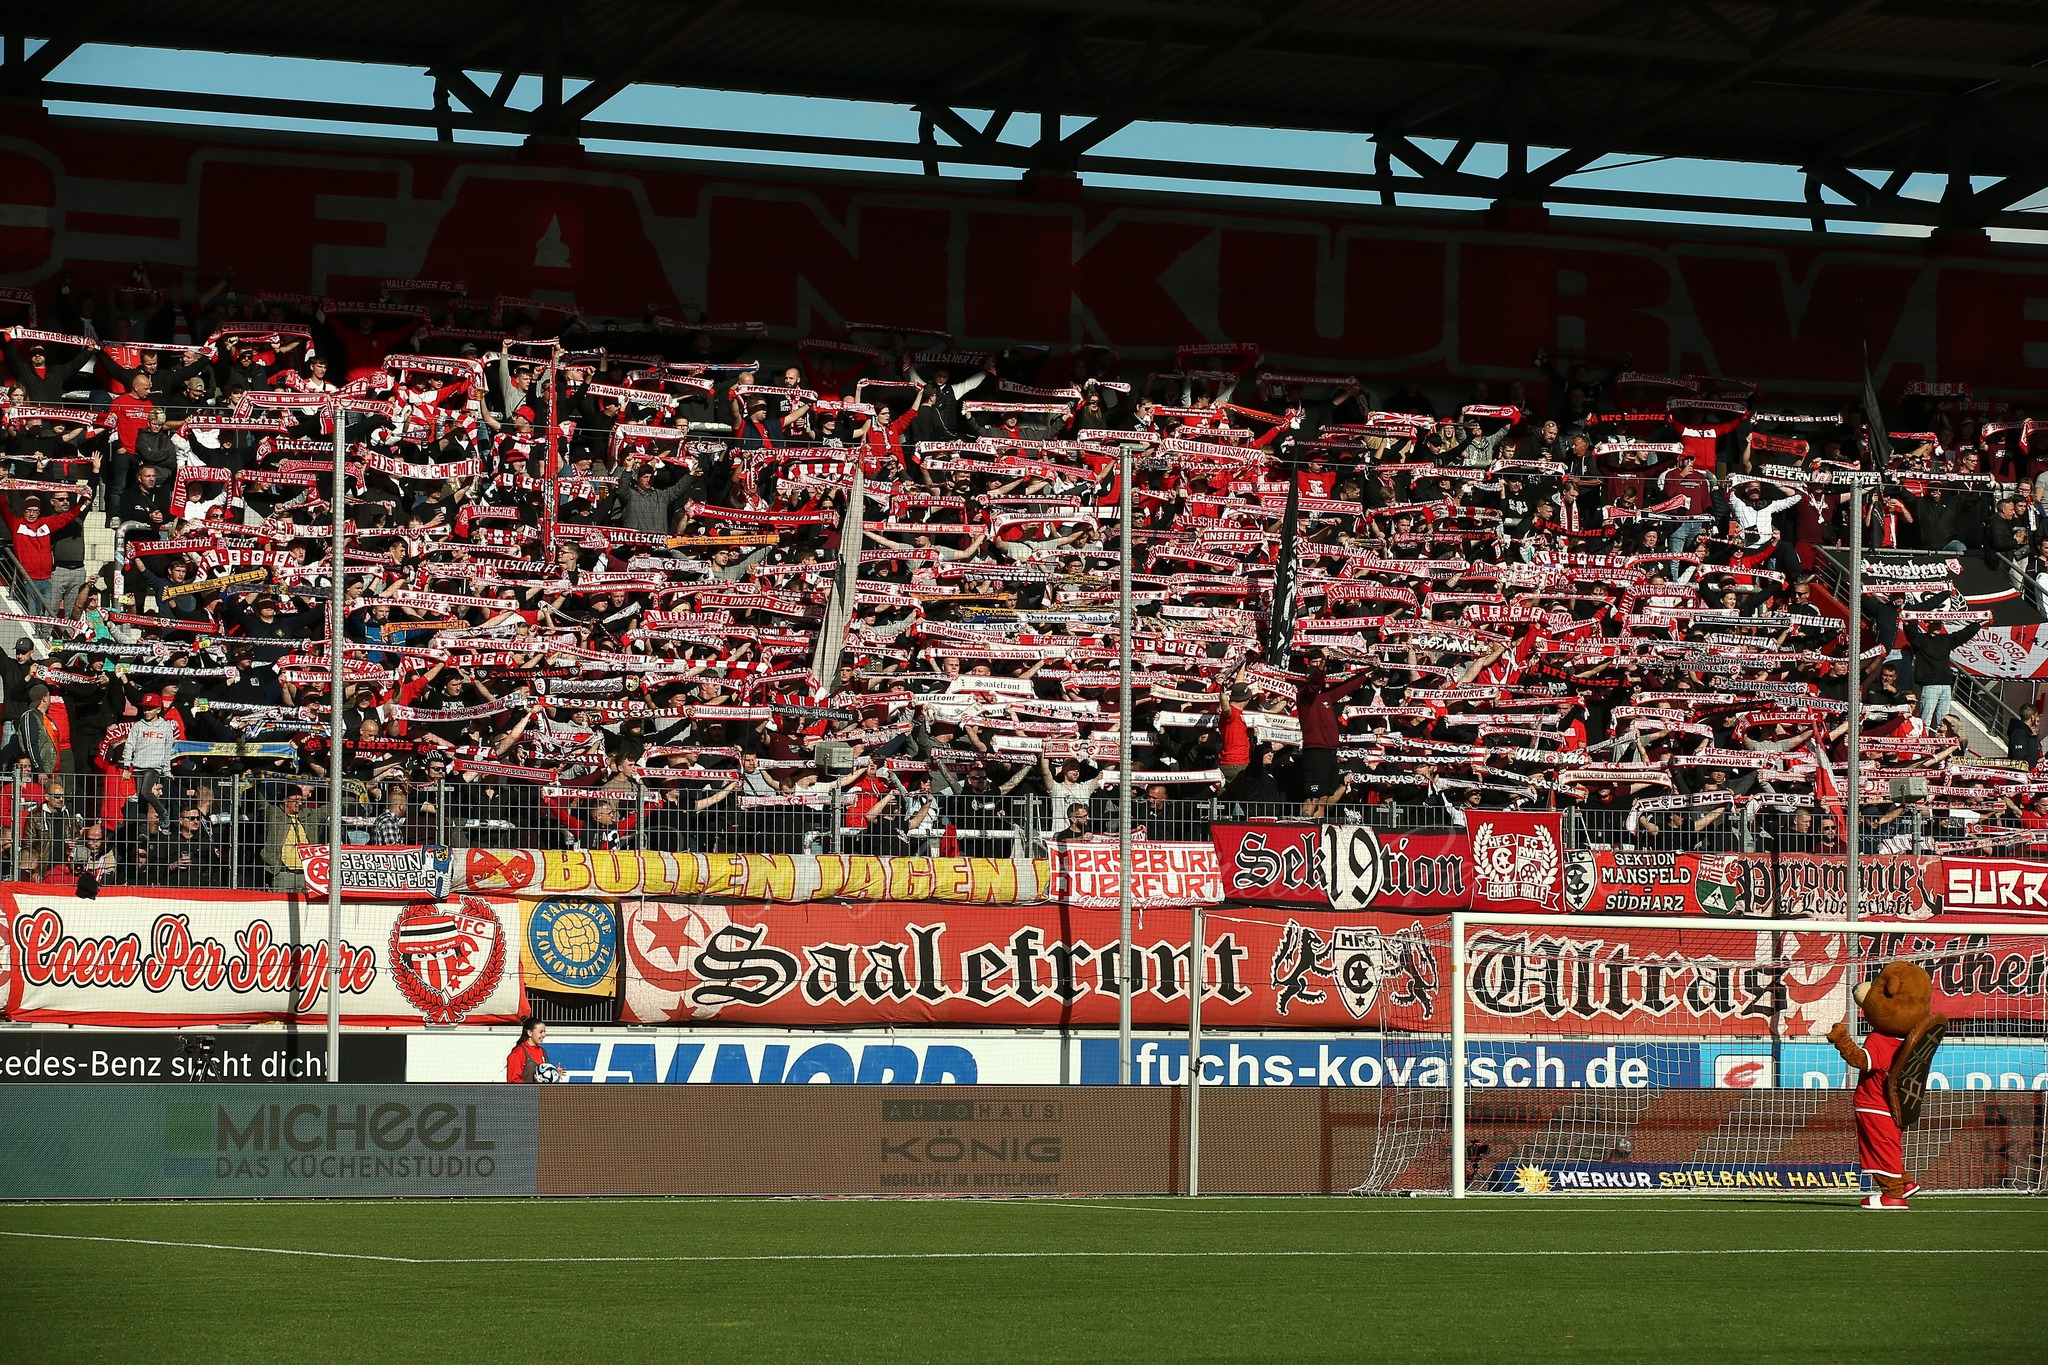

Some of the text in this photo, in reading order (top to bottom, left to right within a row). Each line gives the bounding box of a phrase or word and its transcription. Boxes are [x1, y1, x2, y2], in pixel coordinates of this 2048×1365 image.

[222, 323, 272, 332] CHEMIE
[915, 353, 982, 366] HALLESCHER FC
[639, 372, 704, 386] HFC-FANKURVE
[747, 386, 813, 397] HFC-FANKURVE
[1012, 384, 1076, 396] HFC-FANKURVE
[1676, 400, 1737, 410] HFC-FANKURVE
[18, 408, 93, 420] HFC-FANKURVE
[1601, 414, 1666, 422] HFC CHEMIE
[192, 416, 279, 426] HFC CHEMIE
[1086, 430, 1153, 440] HFC-FANKURVE
[924, 442, 992, 453] HFC-FANKURVE
[1608, 443, 1674, 452] HFC-FANKURVE
[371, 452, 481, 479] EISERN CHEMIE
[1766, 467, 1880, 484] EISERN CHEMIE
[472, 507, 516, 517] HALLESCHER
[925, 524, 940, 532] ROT
[163, 536, 212, 550] HALLESCHER
[478, 558, 560, 575] HALLESCHER FC
[582, 573, 655, 583] HFC-FANKURVE
[364, 597, 439, 611] HFC-FANKURVE
[416, 592, 498, 607] HFC-FANKURVE
[702, 597, 761, 607] HALLE UNSERE
[1306, 618, 1363, 627] HALLESCHER
[1032, 636, 1081, 644] HFC CHEMIE
[1559, 641, 1603, 654] HFC CHEMIE
[942, 649, 1036, 659] KURT-WABBEL-STADION
[130, 664, 224, 676] ALLES GEBEN FÜR CHEMIE
[975, 680, 1020, 690] Saalefront
[1424, 690, 1485, 699] HFC-FANKURVE
[1614, 707, 1683, 720] HFC-FANKURVE
[1752, 712, 1806, 722] HALLESCHER
[358, 740, 415, 751] CHEMIE
[1686, 757, 1752, 766] HFC-FANKURVE
[1671, 793, 1732, 806] CHEMIE
[1488, 836, 1510, 846] HFC
[1524, 838, 1538, 848] FC
[299, 847, 329, 859] HFC
[1519, 849, 1542, 859] RWE
[341, 852, 422, 871] SEKTION
[1614, 853, 1675, 866] SEKTION
[340, 870, 436, 893] EISSENFELS
[543, 850, 796, 901] BULLEN
[811, 855, 1017, 902] JAGEN
[1601, 868, 1691, 884] MANSFELD
[1605, 892, 1685, 912] SÜDHARZ
[1797, 892, 1913, 915] Leideschaft
[541, 899, 613, 936] FANSZENE
[14, 906, 142, 989] Coesa
[142, 914, 227, 994] Per
[536, 929, 613, 980] LOKOMOTIVE
[692, 920, 1251, 1007] Saalefront
[885, 1102, 1058, 1120] AUTOHAUS
[880, 1129, 1063, 1162] KÖNIG
[215, 1151, 496, 1179] DAS KÜCHENSTUDIO
[880, 1171, 1059, 1187] MOBILITÄT IM MITTELPUNKT
[1559, 1171, 1859, 1188] MERKUR SPIELBANK HALLE
